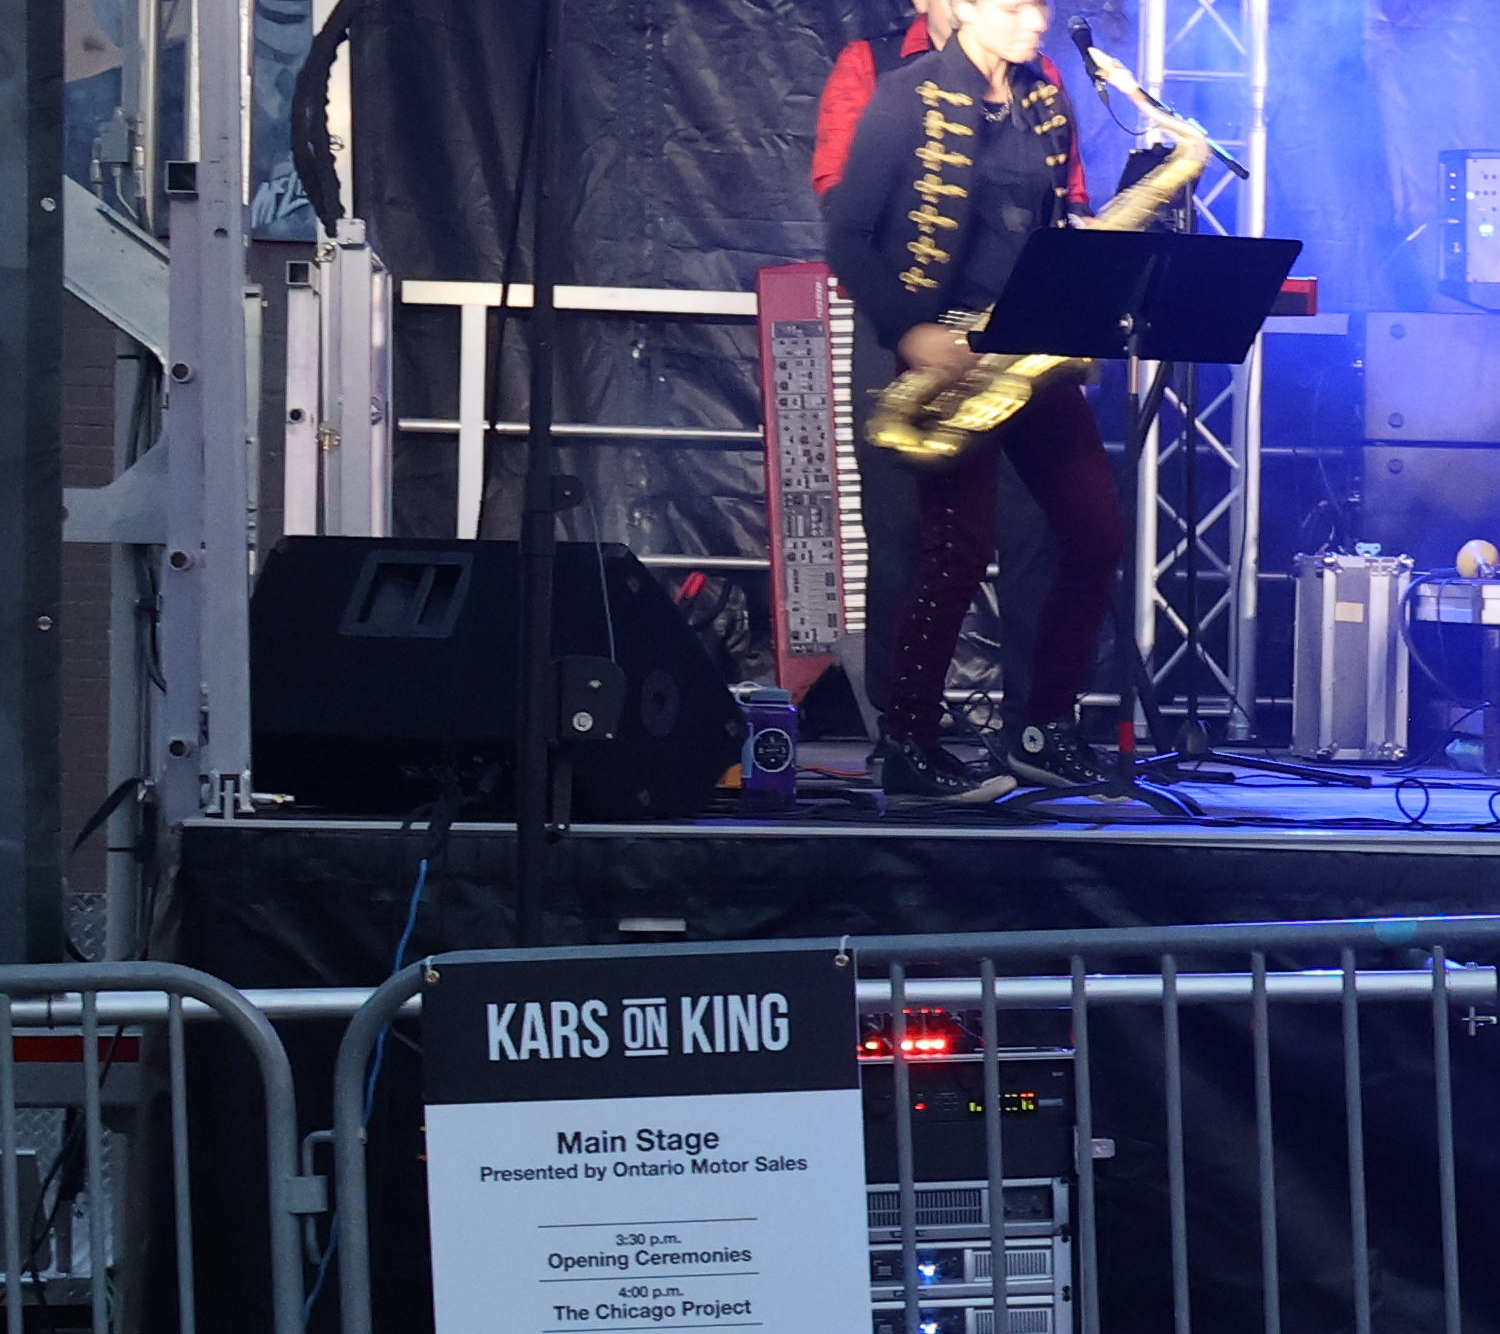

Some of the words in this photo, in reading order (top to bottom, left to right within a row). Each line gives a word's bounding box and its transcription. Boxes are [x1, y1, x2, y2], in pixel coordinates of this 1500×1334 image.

[486, 999, 610, 1062] KARS
[622, 1005, 669, 1050] ON
[681, 992, 790, 1055] KING
[557, 1130, 627, 1154] Main
[635, 1128, 720, 1156] Stage
[480, 1163, 578, 1183] Presented
[584, 1162, 607, 1182] by
[612, 1159, 685, 1177] Ontario
[691, 1158, 750, 1175] Motor
[754, 1155, 809, 1172] Sales
[615, 1233, 646, 1246] 3:30
[649, 1233, 682, 1248] p.m.
[547, 1251, 629, 1272] Opening
[635, 1246, 753, 1266] Ceremonies
[618, 1285, 649, 1299] 4:00
[652, 1286, 685, 1300] p.m.
[552, 1305, 590, 1321] The
[595, 1303, 676, 1322] Chicago
[681, 1299, 752, 1318] Project
